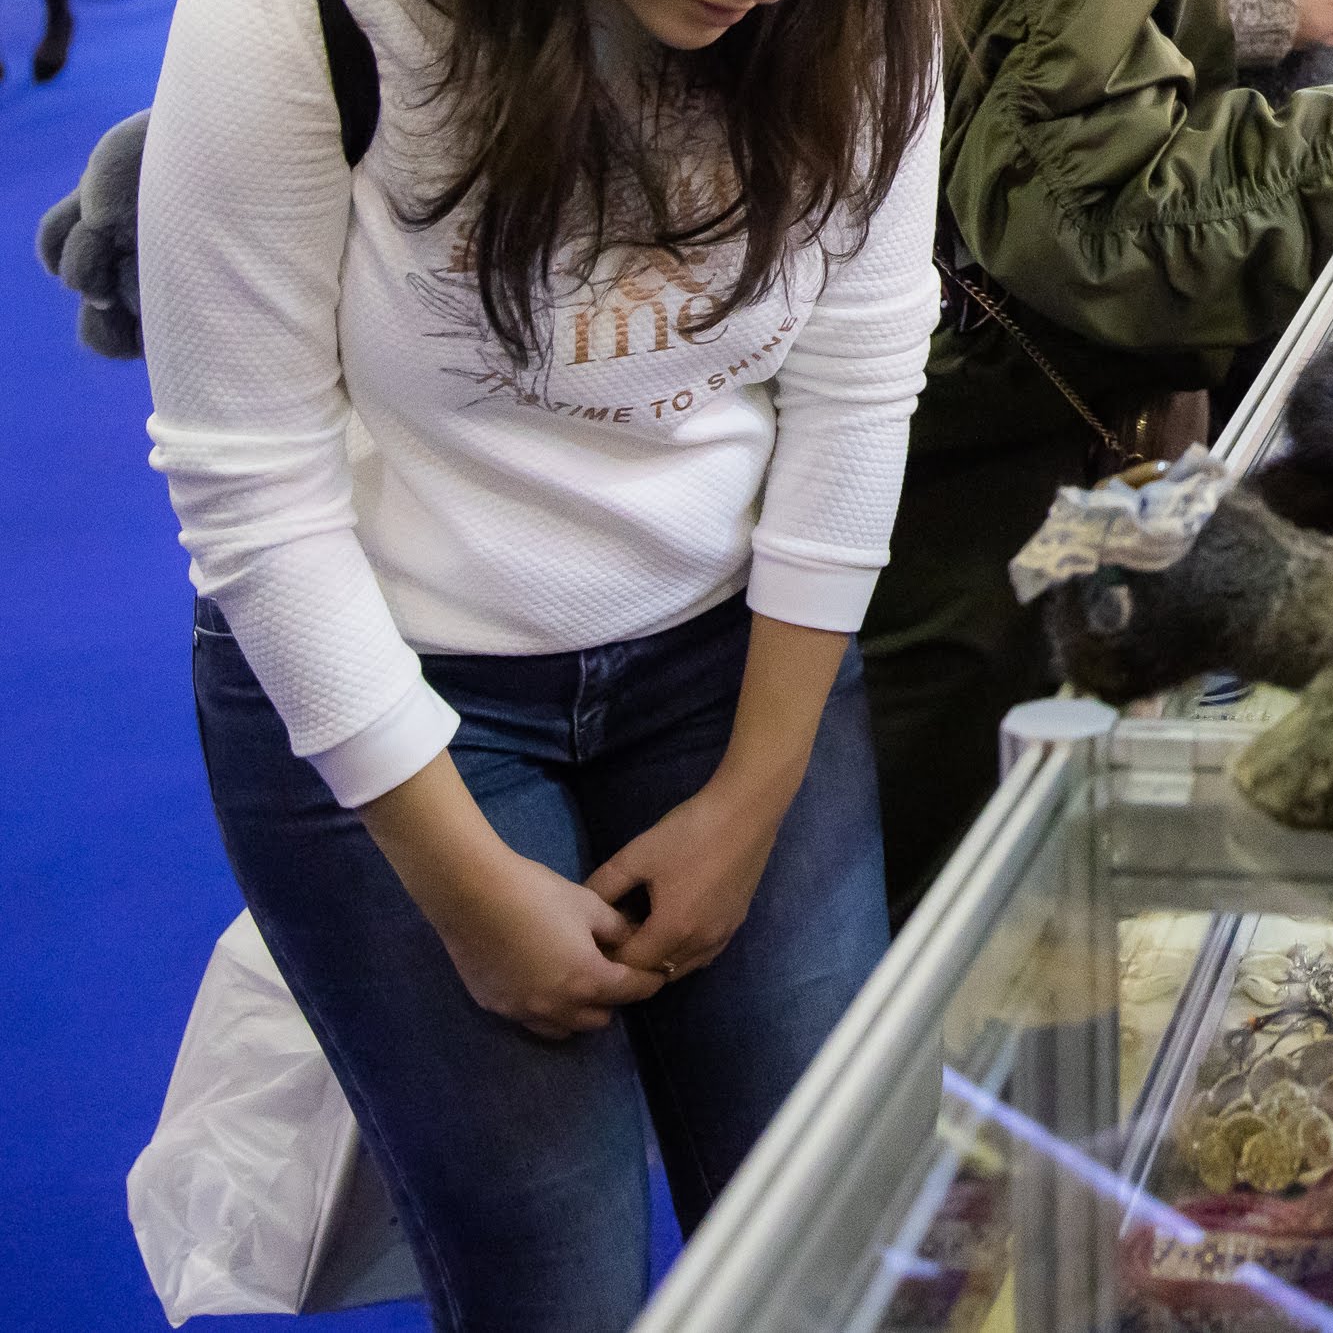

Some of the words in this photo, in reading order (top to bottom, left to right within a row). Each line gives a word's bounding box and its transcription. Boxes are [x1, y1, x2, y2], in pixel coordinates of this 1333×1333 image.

[553, 401, 634, 424] TIME
[649, 389, 694, 420] TO
[706, 315, 799, 392] SHINE
